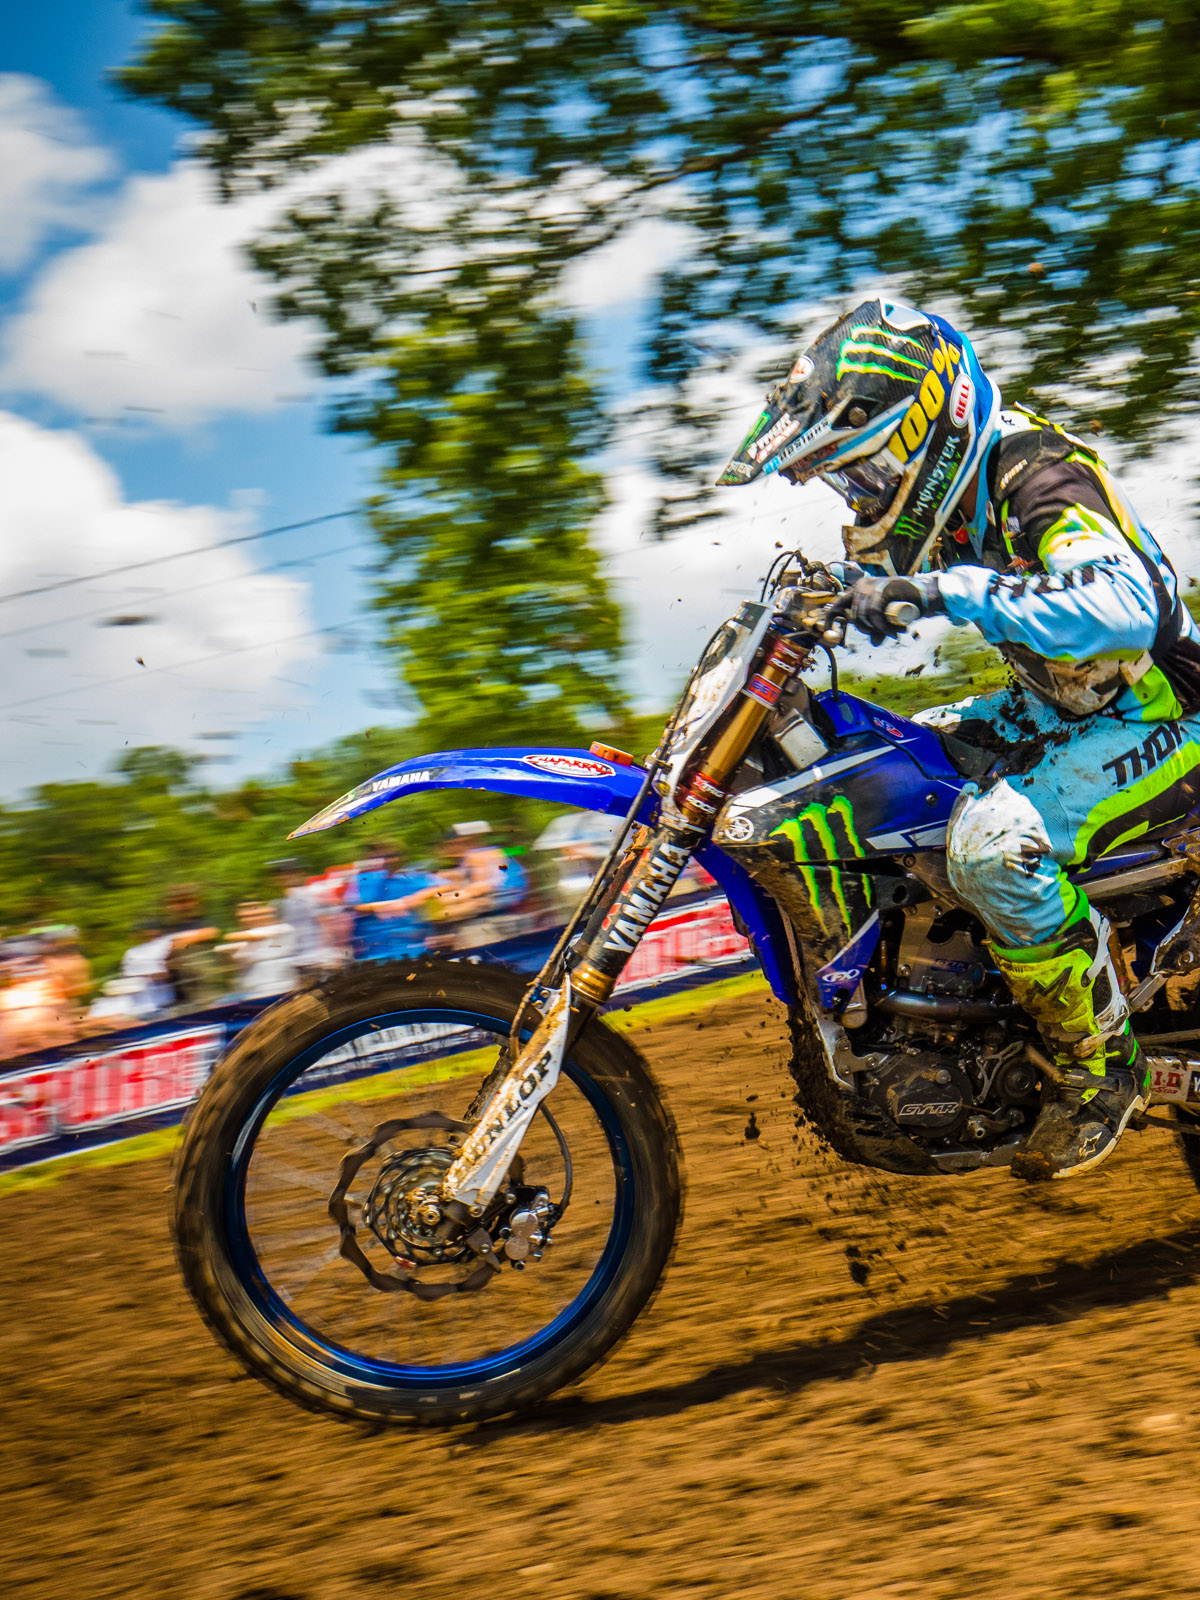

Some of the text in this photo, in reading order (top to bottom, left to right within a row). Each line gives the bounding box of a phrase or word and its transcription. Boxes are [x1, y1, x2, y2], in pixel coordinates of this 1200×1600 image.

[888, 335, 961, 463] 100%
[955, 383, 970, 419] BELL
[912, 434, 960, 516] MONSTER
[371, 771, 430, 793] YAMAHA
[603, 842, 692, 953] YAMAHA
[899, 1101, 960, 1116] GYTR
